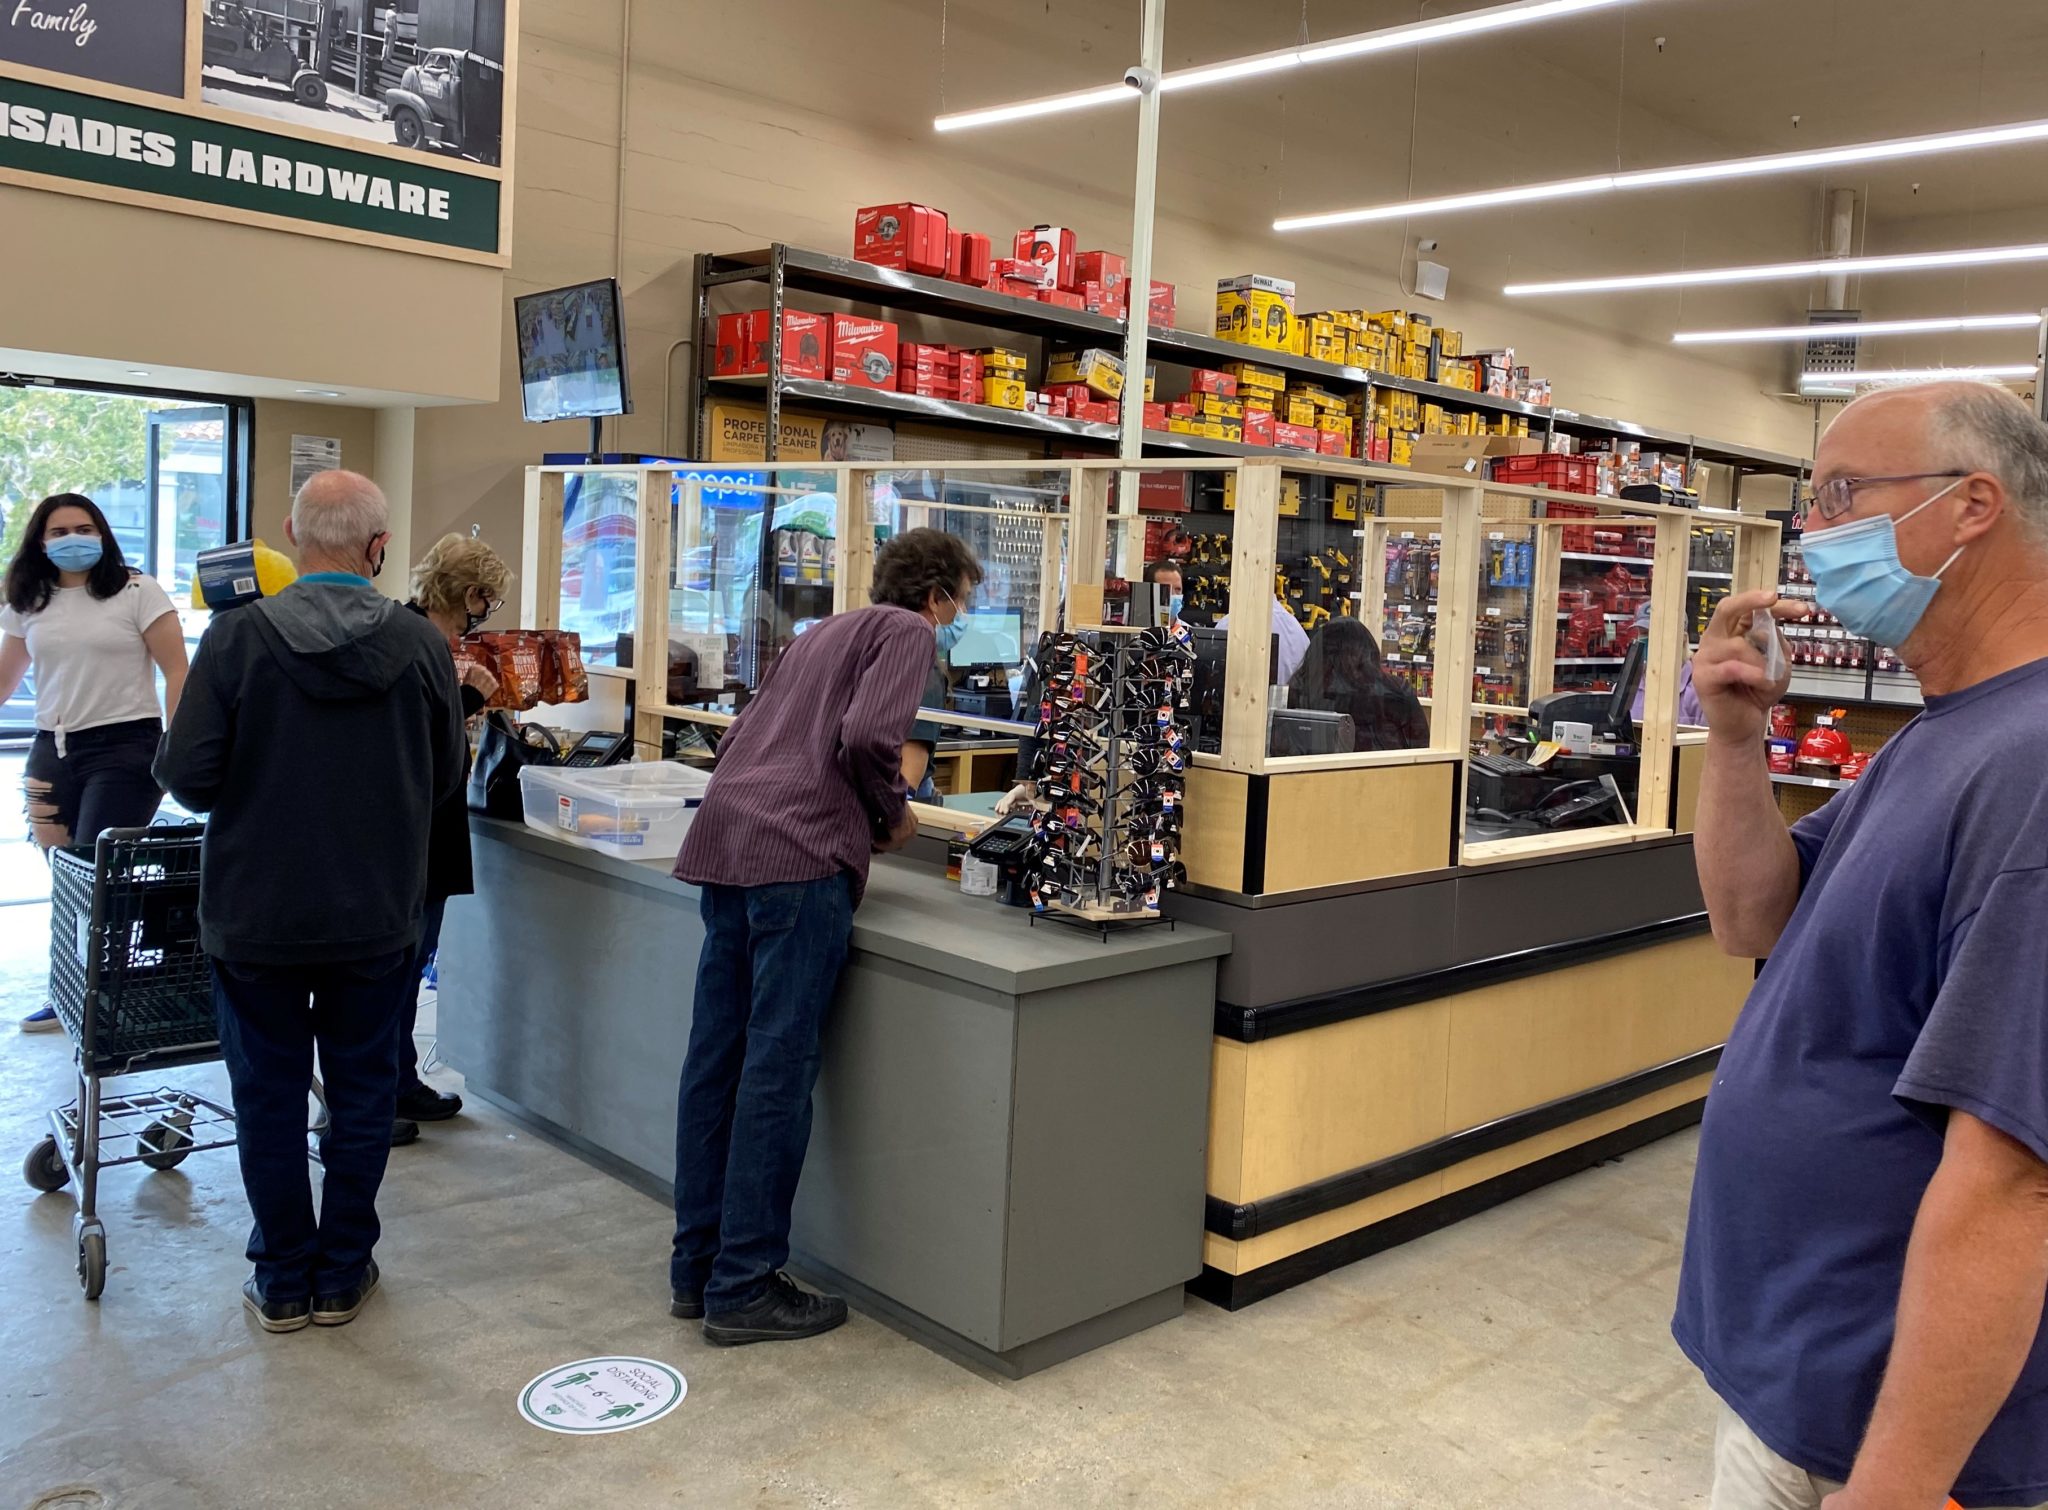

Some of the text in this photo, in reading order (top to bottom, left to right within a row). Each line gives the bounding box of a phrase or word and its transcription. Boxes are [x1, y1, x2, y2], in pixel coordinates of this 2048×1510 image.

[11, 0, 97, 46] Family
[192, 141, 450, 220] HARDWARE
[836, 319, 885, 338] Milwaukee
[724, 417, 817, 440] PROFEIONAL
[777, 438, 817, 450] LEANER
[606, 1366, 659, 1401] DISTANCING
[629, 1367, 661, 1389] SOCIAL
